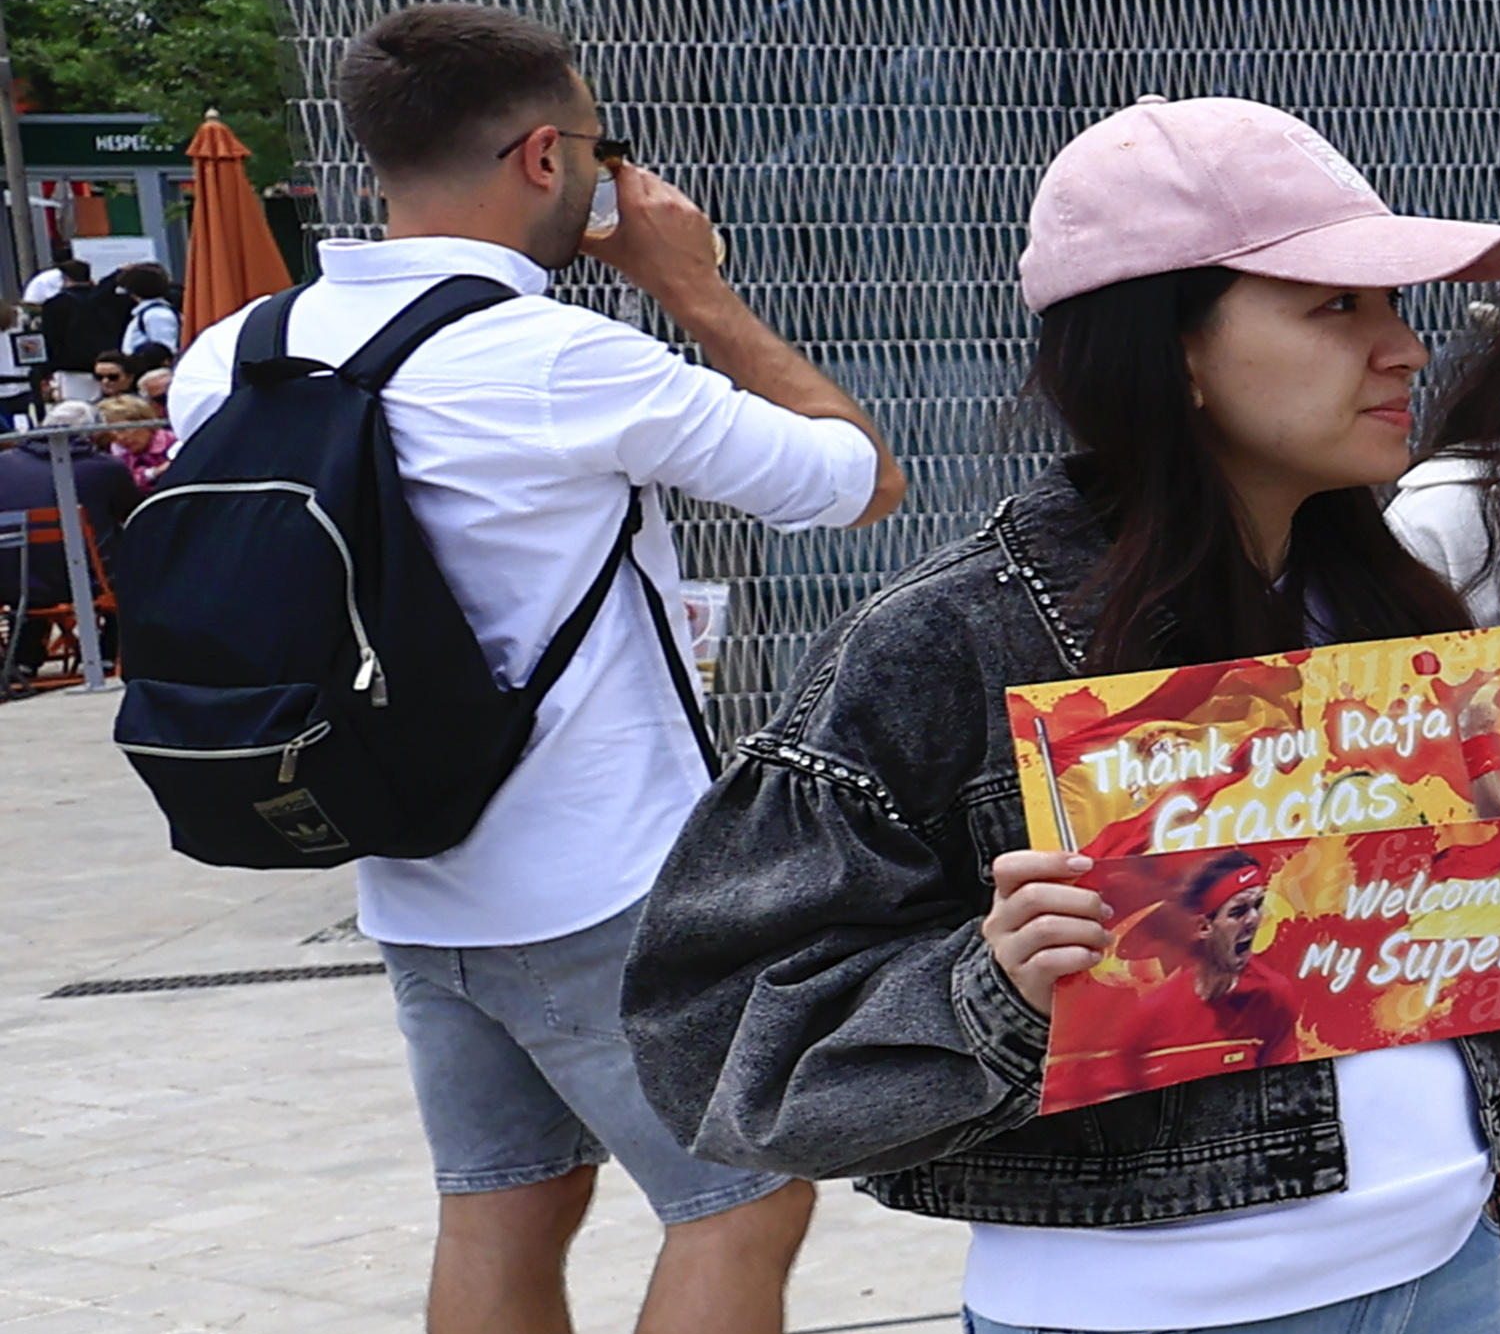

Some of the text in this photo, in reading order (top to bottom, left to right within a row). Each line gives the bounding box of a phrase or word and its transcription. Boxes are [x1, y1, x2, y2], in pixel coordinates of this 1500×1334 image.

[1080, 695, 1453, 794] Thank you Rafa
[1152, 772, 1399, 854] Gracias
[1298, 940, 1362, 994] My
